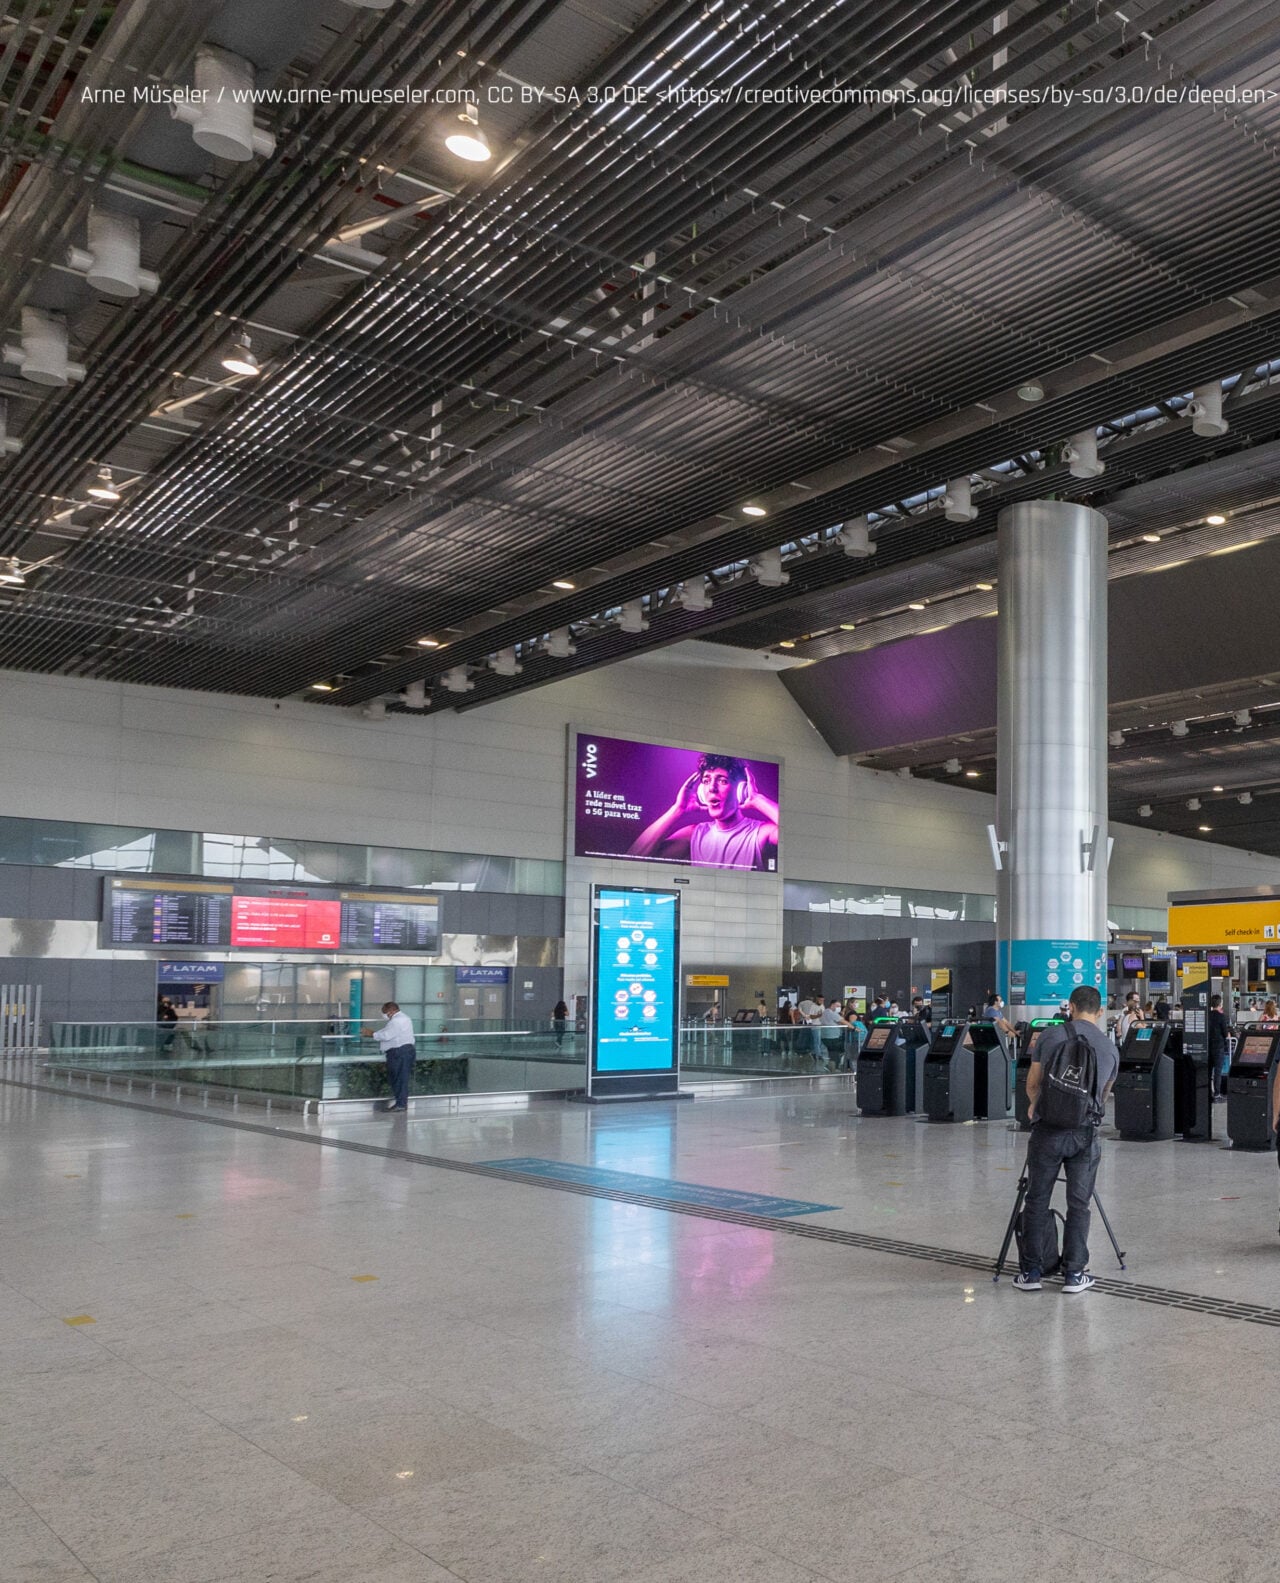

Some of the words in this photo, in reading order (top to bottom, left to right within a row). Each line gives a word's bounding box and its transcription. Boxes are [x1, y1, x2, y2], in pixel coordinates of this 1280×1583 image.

[582, 744, 598, 778] vivo
[585, 790, 592, 798] A
[593, 790, 612, 800] líder
[585, 799, 603, 807] rede
[604, 801, 626, 810] móvel
[627, 803, 643, 812] traz
[592, 808, 603, 816] 5G
[604, 810, 621, 818] para
[1224, 928, 1236, 937] Self
[1236, 927, 1260, 936] check-in
